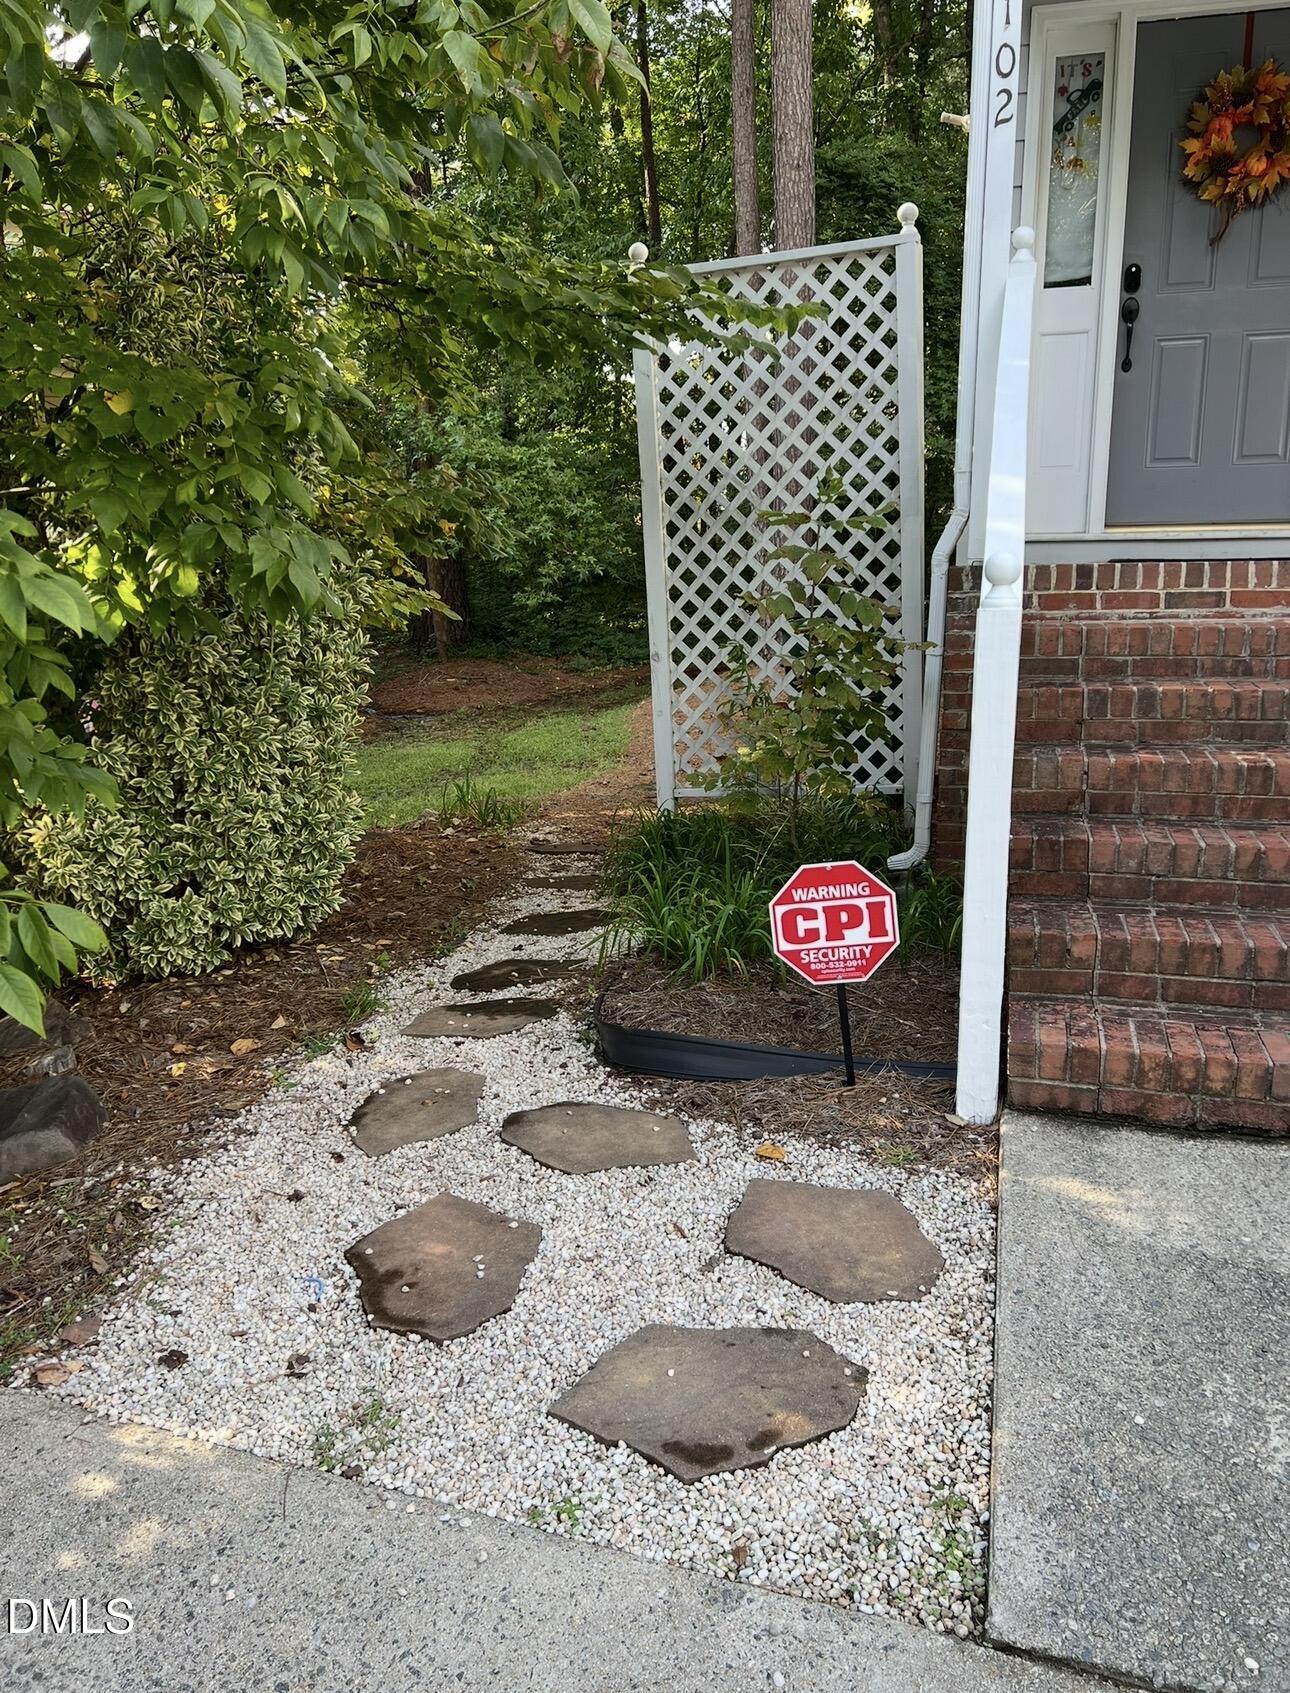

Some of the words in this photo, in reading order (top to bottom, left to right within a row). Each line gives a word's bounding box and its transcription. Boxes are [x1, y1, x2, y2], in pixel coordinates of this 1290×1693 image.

[994, 0, 1016, 128] 102
[1060, 59, 1093, 79] IT'S
[791, 882, 870, 902] WARNING
[781, 901, 889, 945] CPI
[800, 945, 873, 963] SECURITY
[810, 959, 867, 970] 800-532-0911
